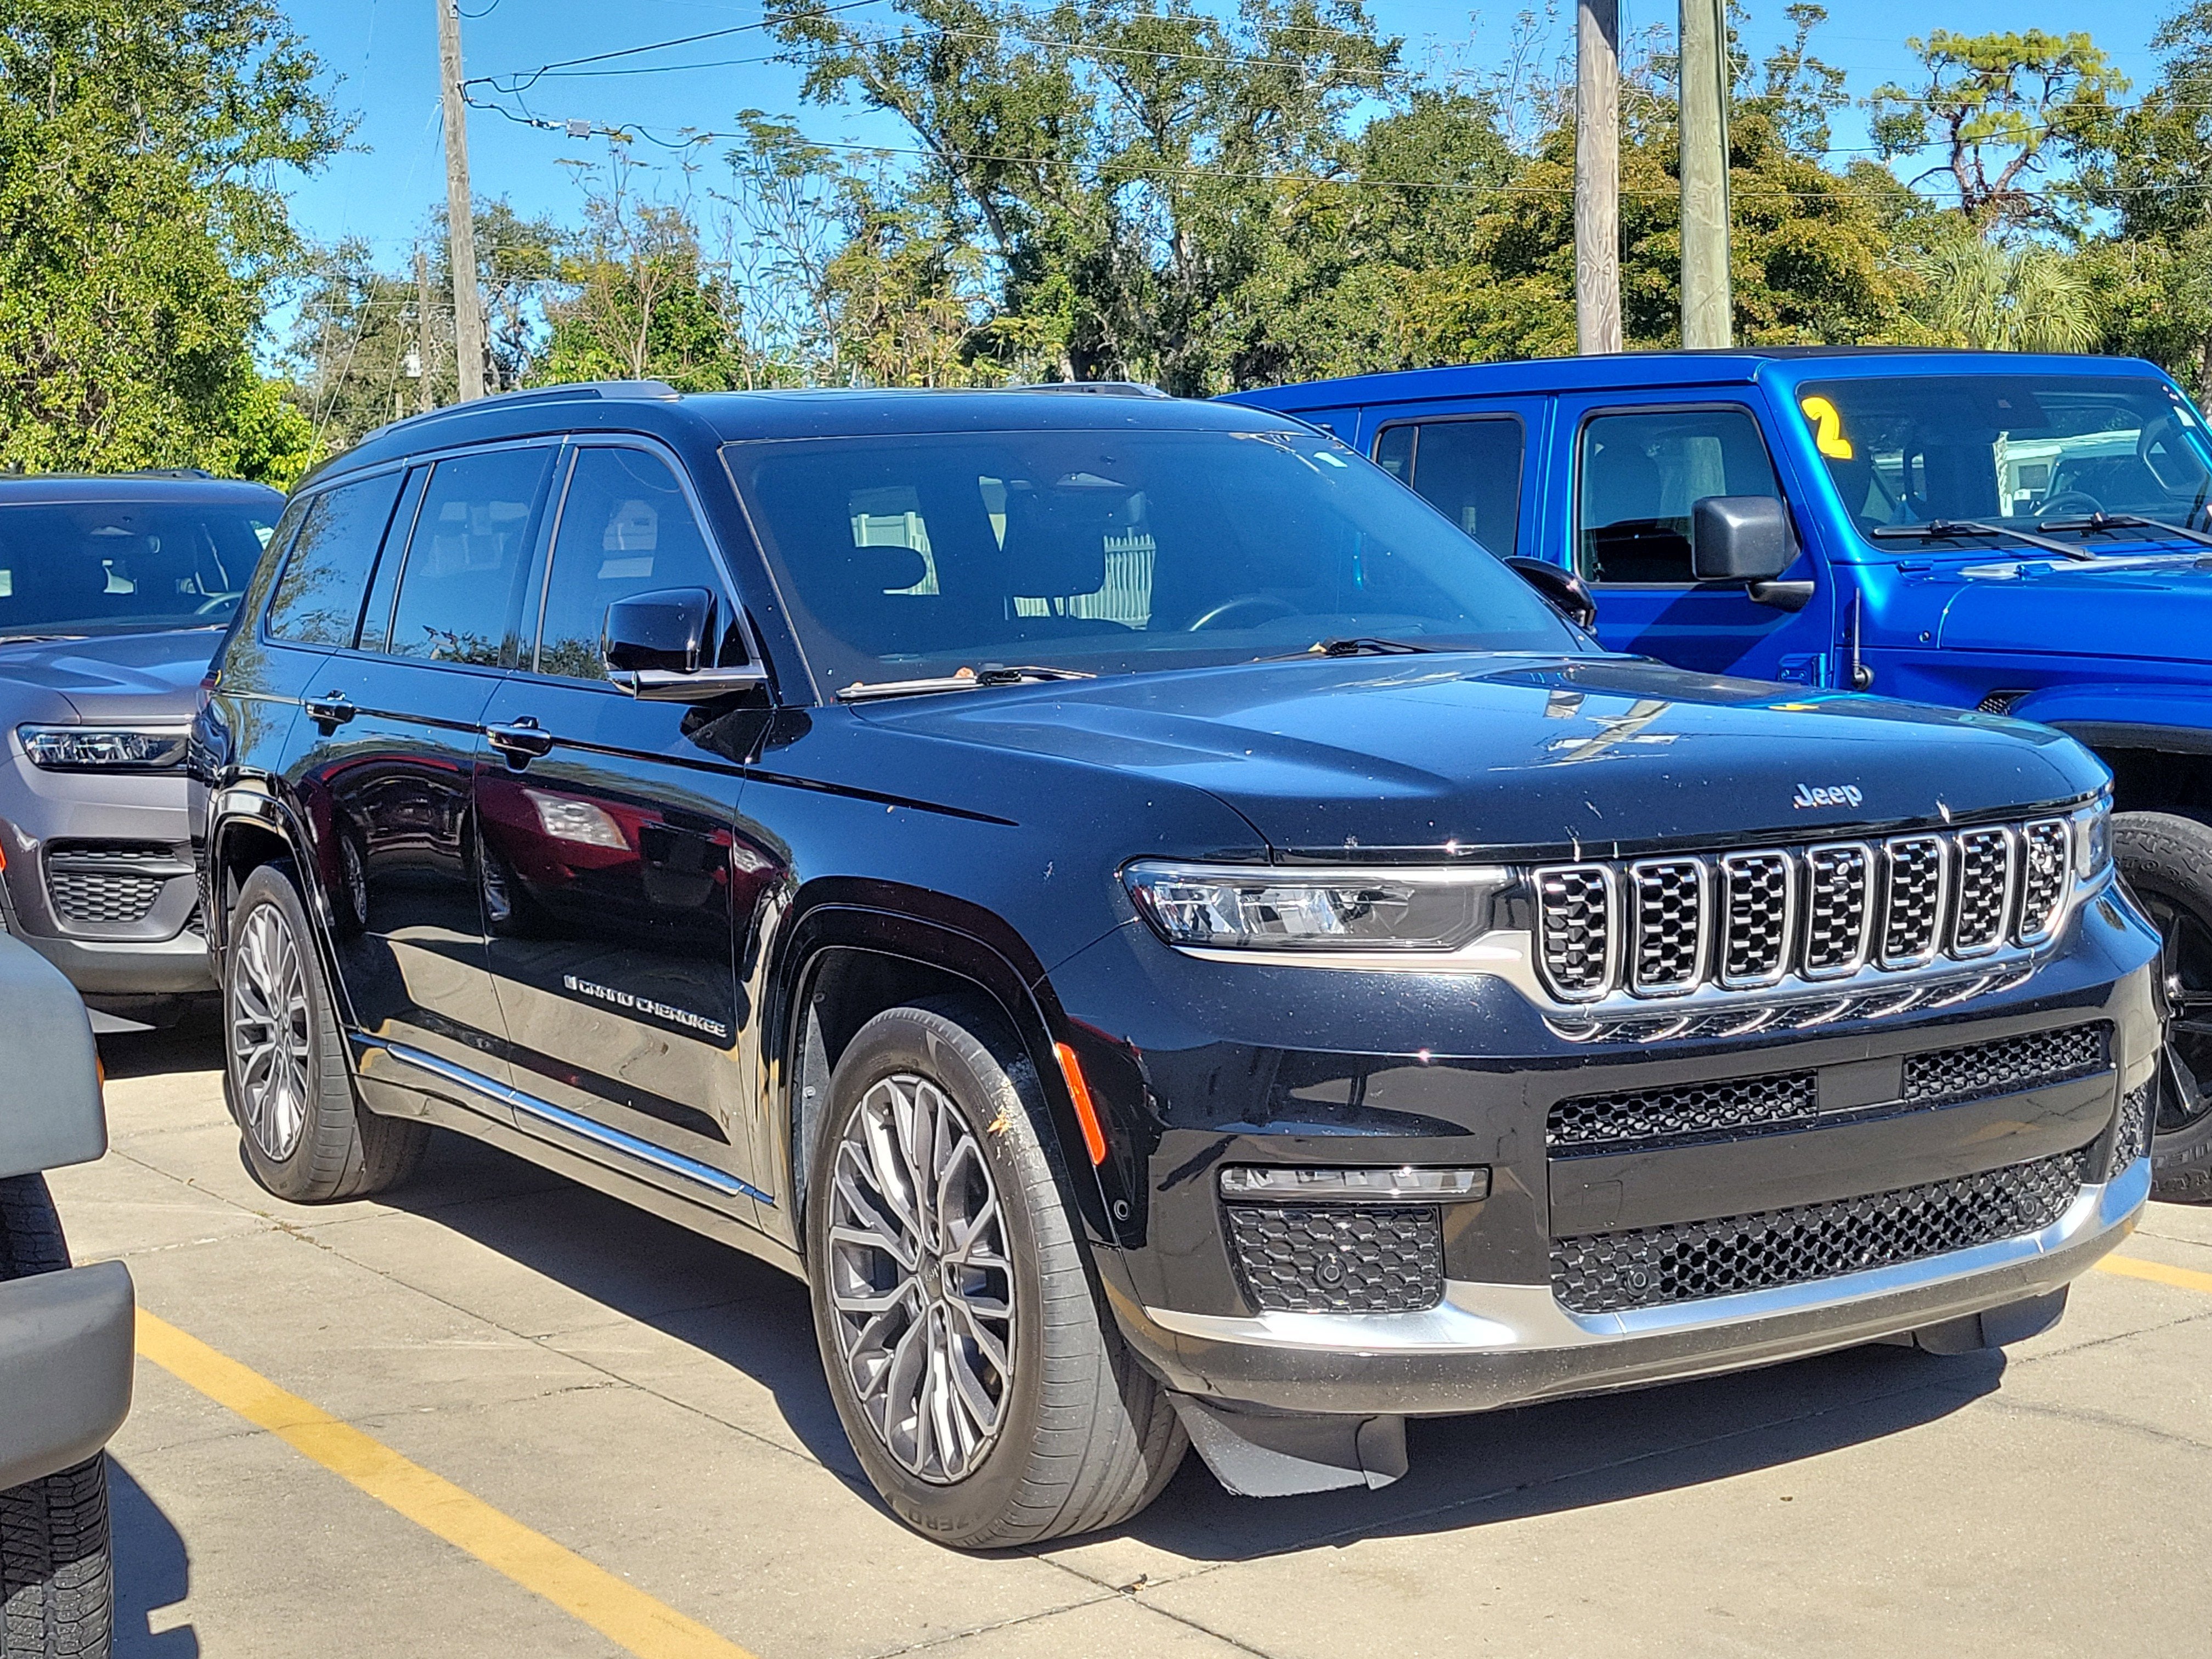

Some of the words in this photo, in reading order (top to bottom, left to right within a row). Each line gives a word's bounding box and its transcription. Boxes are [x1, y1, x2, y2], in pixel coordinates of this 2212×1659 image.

[1802, 397, 1852, 459] 2
[1793, 783, 1863, 809] Jeep
[578, 979, 634, 1007] GRAND
[636, 997, 727, 1038] CHEROKEE
